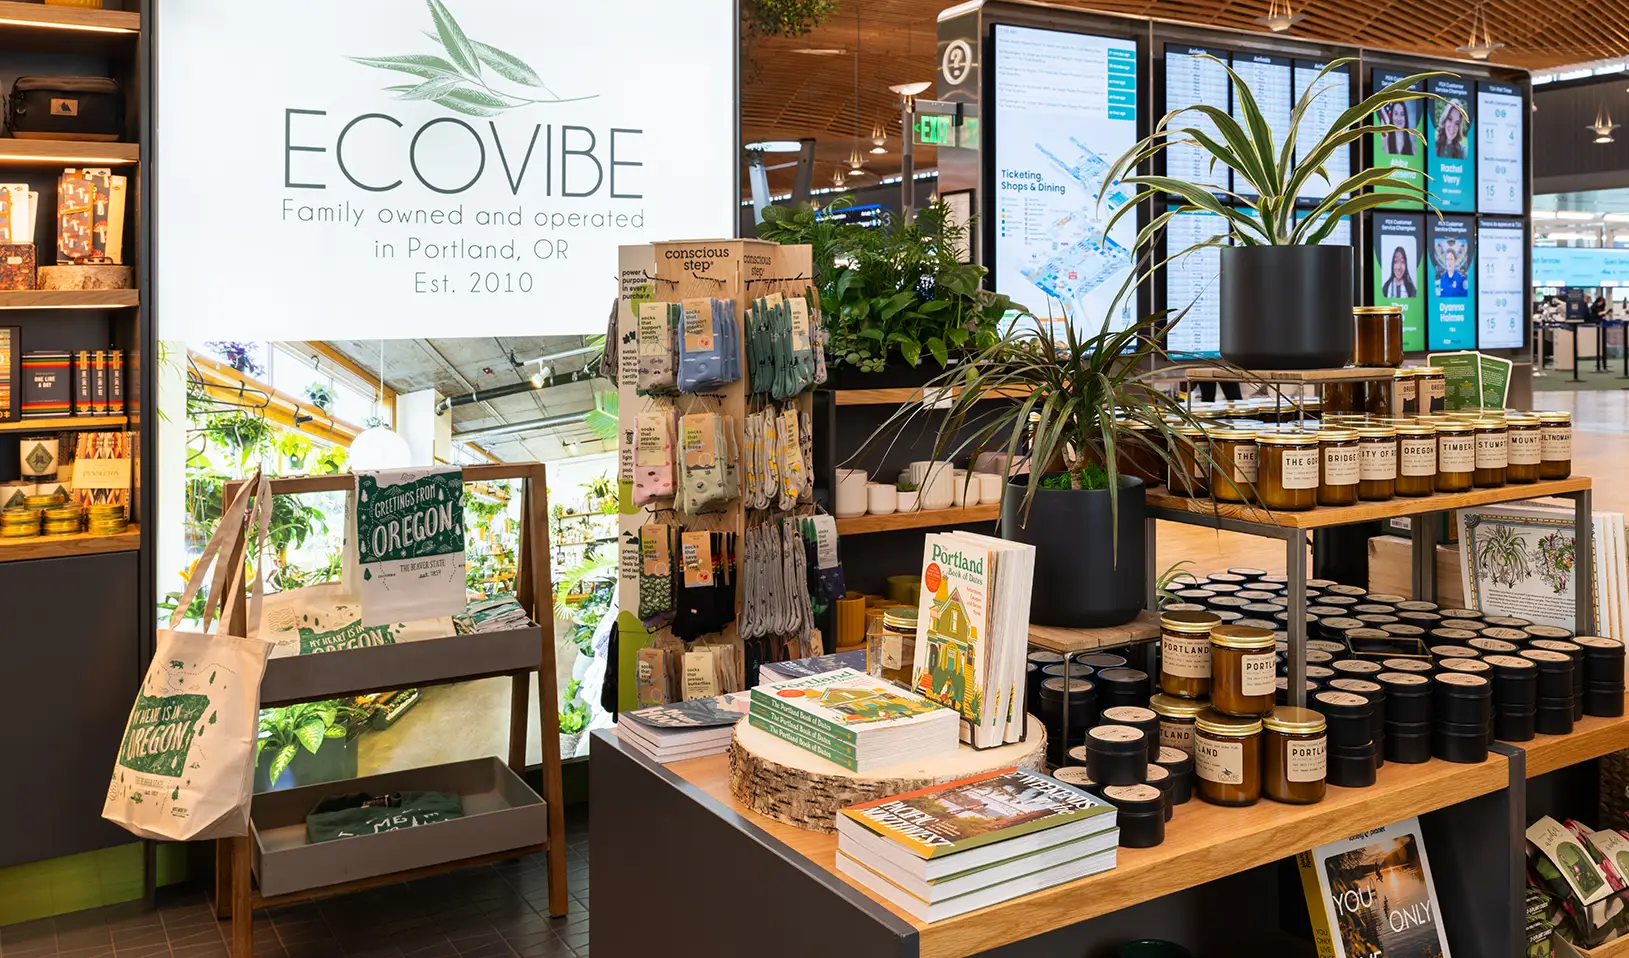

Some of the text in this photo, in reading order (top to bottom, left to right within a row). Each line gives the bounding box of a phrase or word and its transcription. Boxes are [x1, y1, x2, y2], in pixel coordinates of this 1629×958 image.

[920, 115, 950, 143] EXIT
[1509, 131, 1514, 140] 4
[284, 108, 643, 199] ECOVIBE
[1001, 169, 1044, 182] Ticketing,
[1001, 182, 1028, 192] Shops
[1038, 184, 1066, 195] Dining
[282, 198, 644, 230] Family owned and operated
[374, 238, 568, 262] in Portland, OR
[665, 247, 729, 259] conscious
[743, 255, 771, 266] conscious
[414, 272, 534, 294] Est. 2010
[1328, 453, 1356, 462] BRIDGE
[374, 484, 436, 518] GREETINGS FROM
[372, 500, 453, 558] OREGON
[411, 561, 429, 571] BEAVER
[430, 559, 446, 567] STATE
[932, 544, 983, 575] Portland
[948, 568, 961, 578] Book
[969, 573, 983, 585] Dates
[309, 638, 321, 648] MY
[321, 634, 347, 645] HEART
[357, 625, 364, 634] IN
[1164, 642, 1209, 654] PORTLAND
[772, 671, 854, 690] Portland
[140, 704, 183, 724] HEART IS IN
[781, 702, 799, 716] Portland
[800, 711, 811, 720] Book
[818, 720, 832, 731] Dates
[126, 720, 191, 761] OREGON
[770, 725, 831, 758] The Portland Book of Dates
[780, 715, 799, 729] Portland
[800, 724, 811, 734] Book
[812, 730, 817, 739] of
[818, 734, 831, 746] Dates
[1292, 748, 1326, 757] PORTLA
[1370, 826, 1386, 836] planet
[1332, 884, 1372, 916] YOU
[1389, 900, 1432, 932] ONLY
